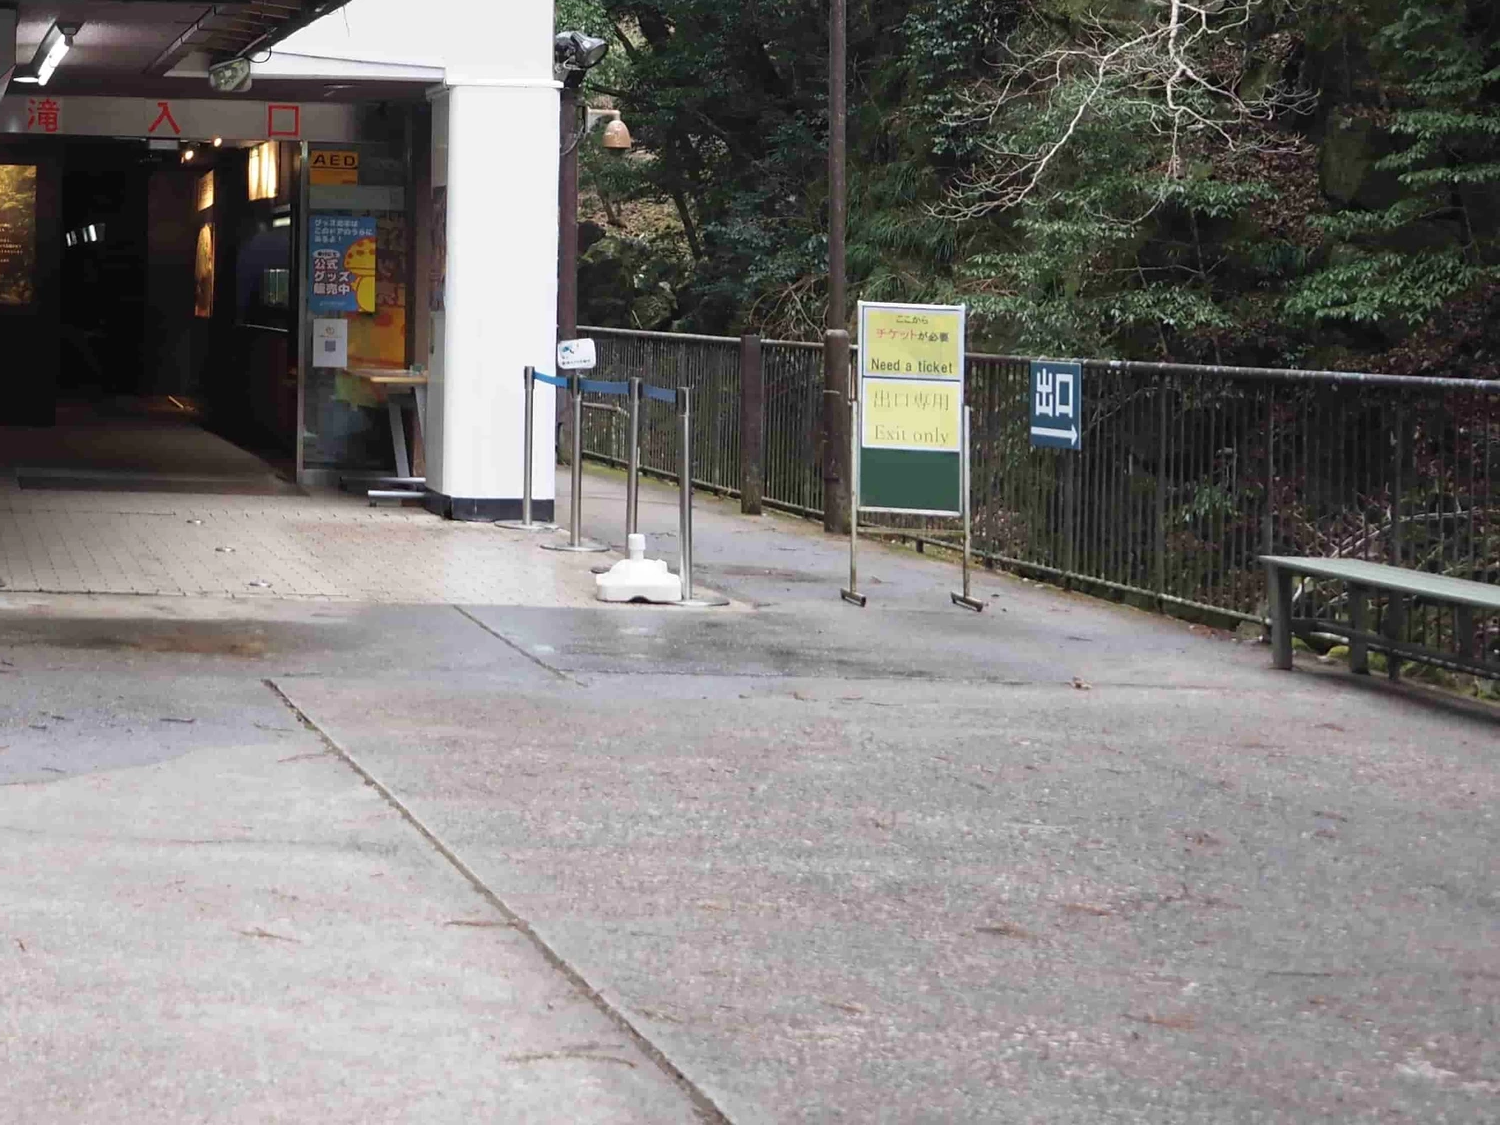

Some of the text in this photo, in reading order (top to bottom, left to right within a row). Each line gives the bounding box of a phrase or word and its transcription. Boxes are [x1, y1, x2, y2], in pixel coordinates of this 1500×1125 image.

[313, 153, 356, 167] AED
[314, 258, 338, 270] 公式
[314, 271, 350, 282] グッズ
[896, 315, 928, 325] ここから
[876, 328, 949, 343] チケットが必要
[871, 358, 953, 374] Need a ticket
[1035, 367, 1073, 418] 出口
[874, 389, 949, 412] 出口専用
[875, 425, 949, 447] Exit only
